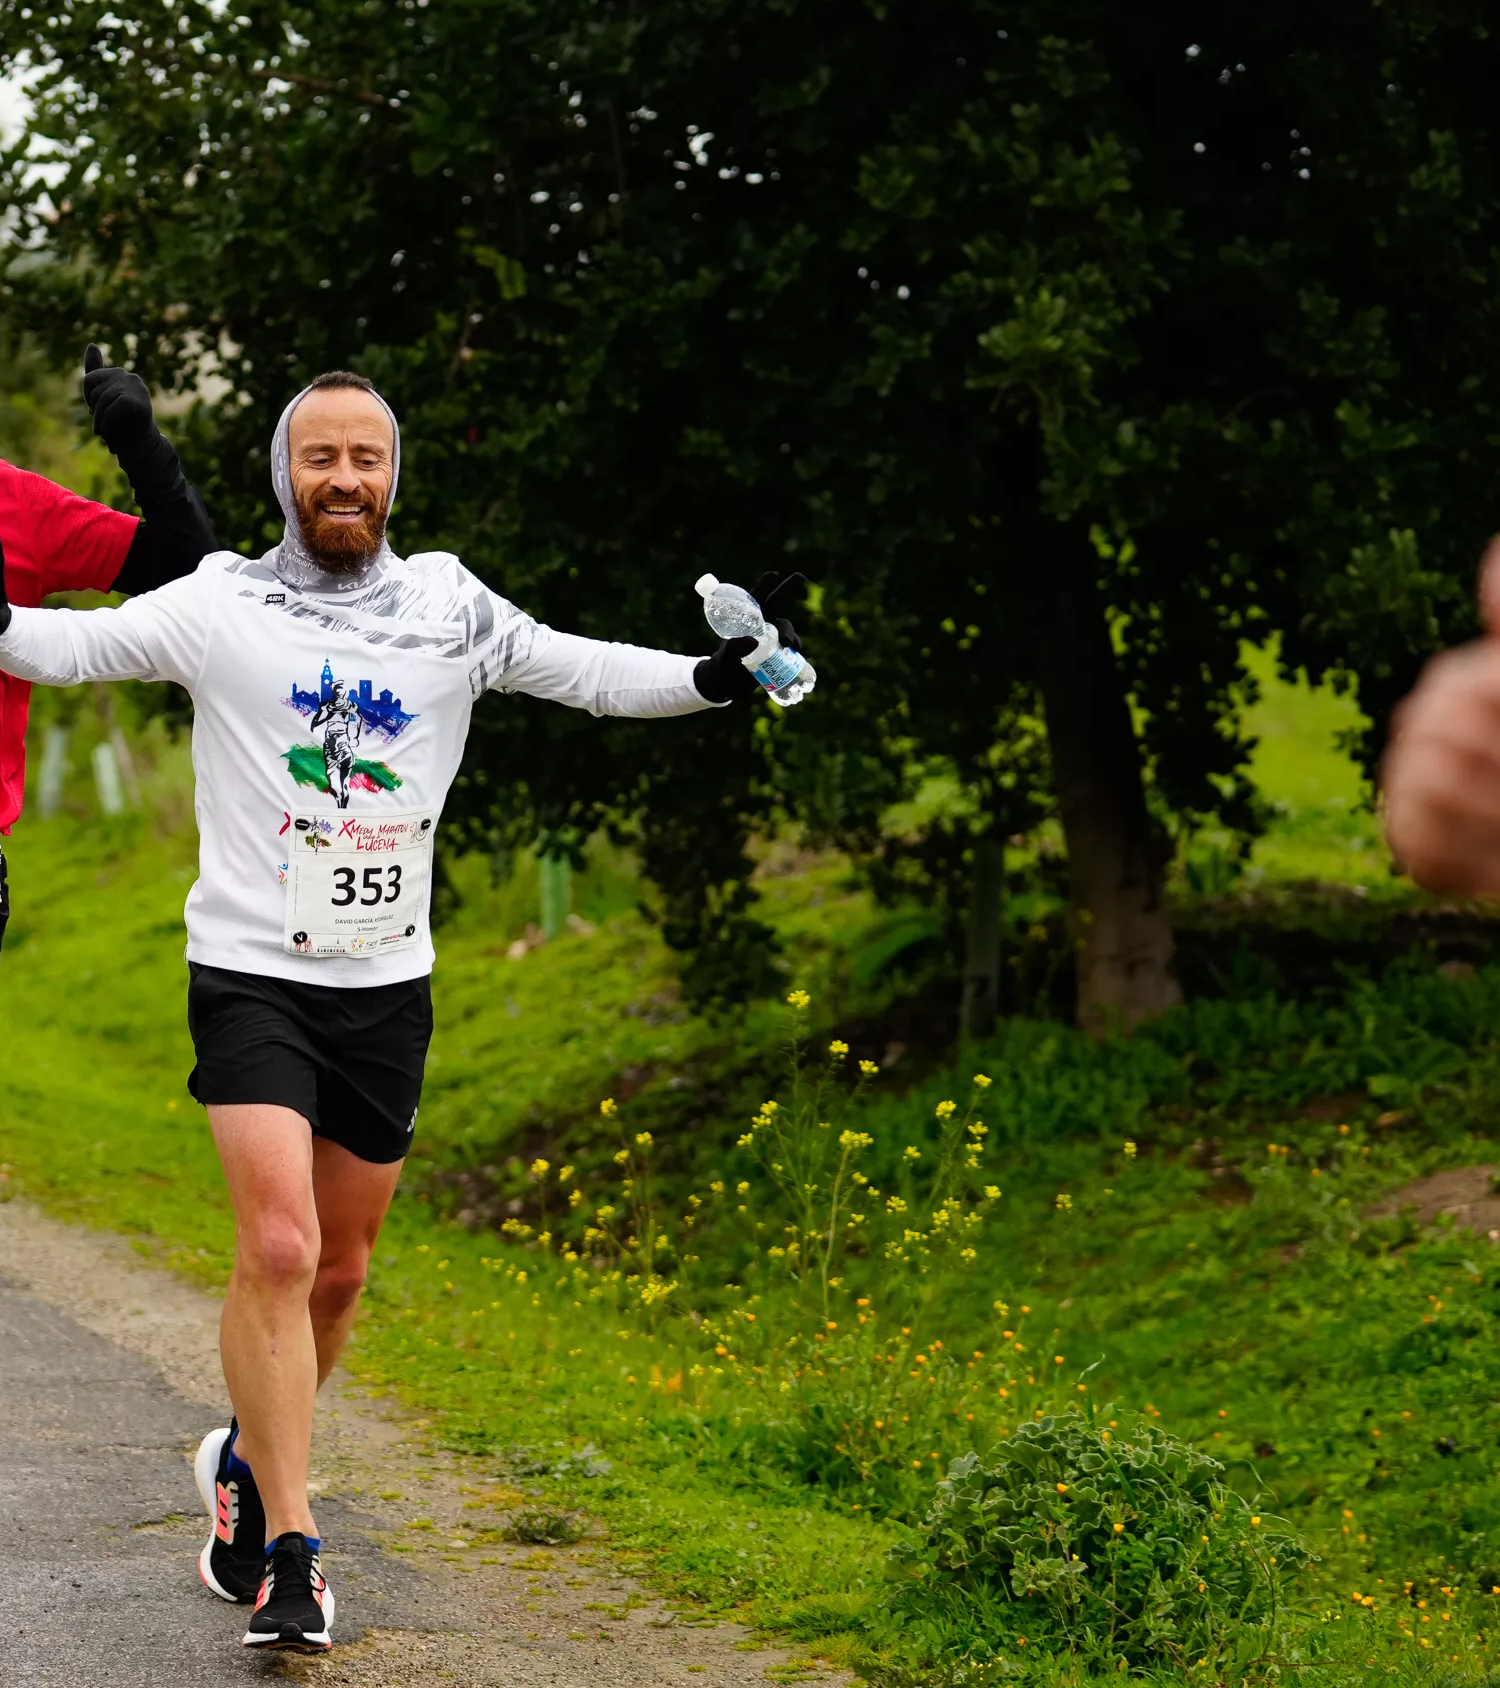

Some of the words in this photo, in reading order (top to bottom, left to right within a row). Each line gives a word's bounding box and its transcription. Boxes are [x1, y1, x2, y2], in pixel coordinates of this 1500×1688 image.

[356, 837, 400, 852] LUCENA
[331, 864, 402, 906] 353
[354, 917, 374, 925] GARCÍA
